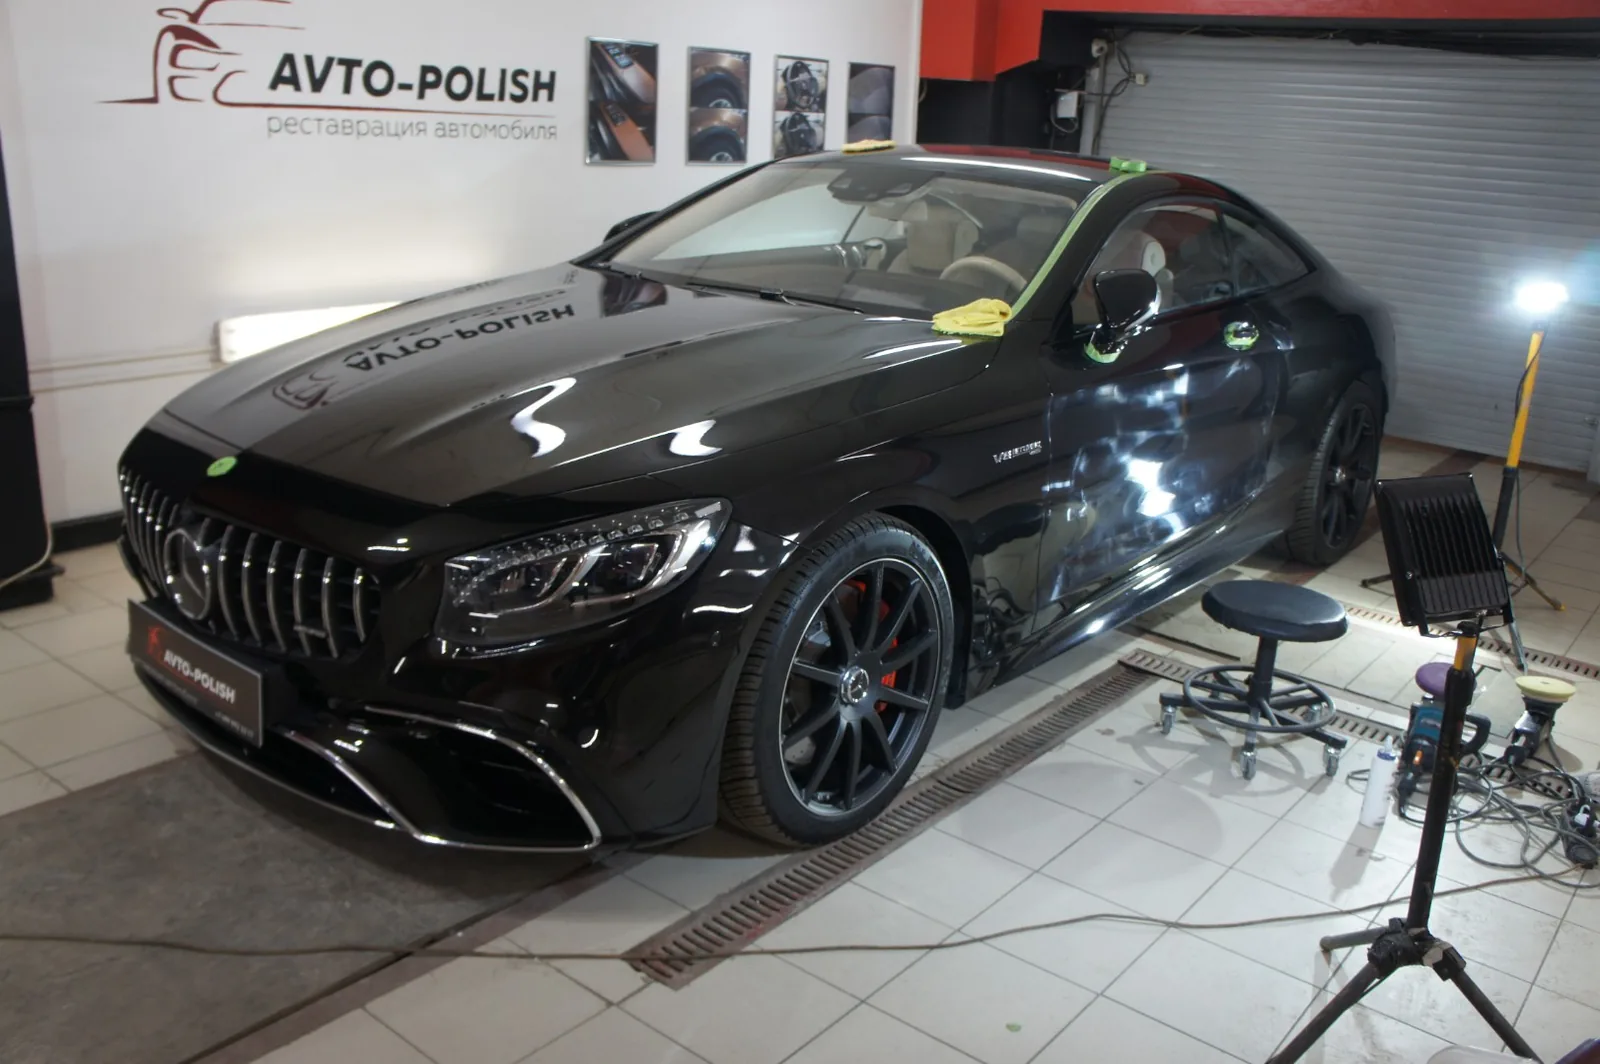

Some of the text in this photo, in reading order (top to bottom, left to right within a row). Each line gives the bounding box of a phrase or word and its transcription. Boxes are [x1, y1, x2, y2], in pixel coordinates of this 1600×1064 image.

[268, 52, 557, 104] AVTO-POLISH
[266, 115, 558, 141] реставрация автомобиля
[163, 648, 237, 705] AVTO-POLISH
